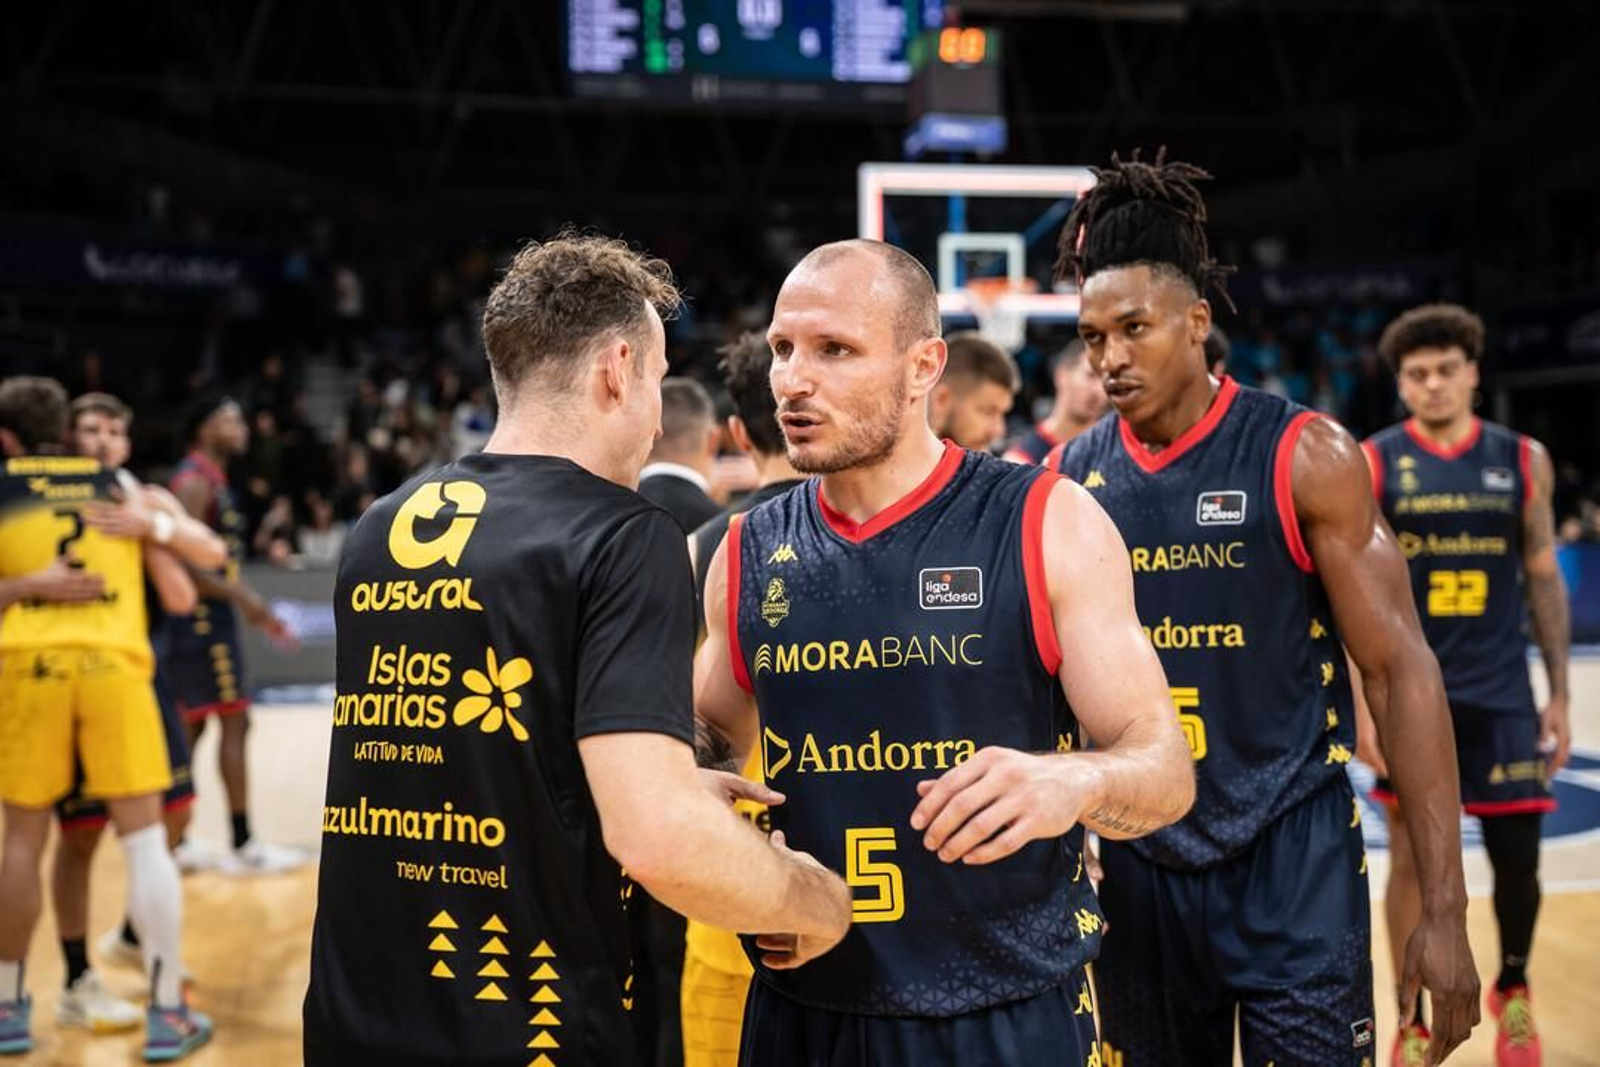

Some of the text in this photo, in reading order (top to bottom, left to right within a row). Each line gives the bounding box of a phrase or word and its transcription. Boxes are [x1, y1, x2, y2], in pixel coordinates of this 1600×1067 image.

[1132, 541, 1246, 573] RABANC
[352, 577, 484, 613] austral
[925, 580, 950, 594] liga
[926, 590, 978, 604] endesa
[1428, 569, 1489, 617] 22
[1142, 615, 1246, 650] dorra
[367, 643, 452, 687] Islas
[775, 633, 984, 675] MORABANC
[335, 685, 447, 730] anarias
[354, 741, 445, 765] LATITUD DE VIDA
[796, 729, 977, 774] Andorra
[397, 860, 509, 890] new travel
[845, 827, 905, 923] 5
